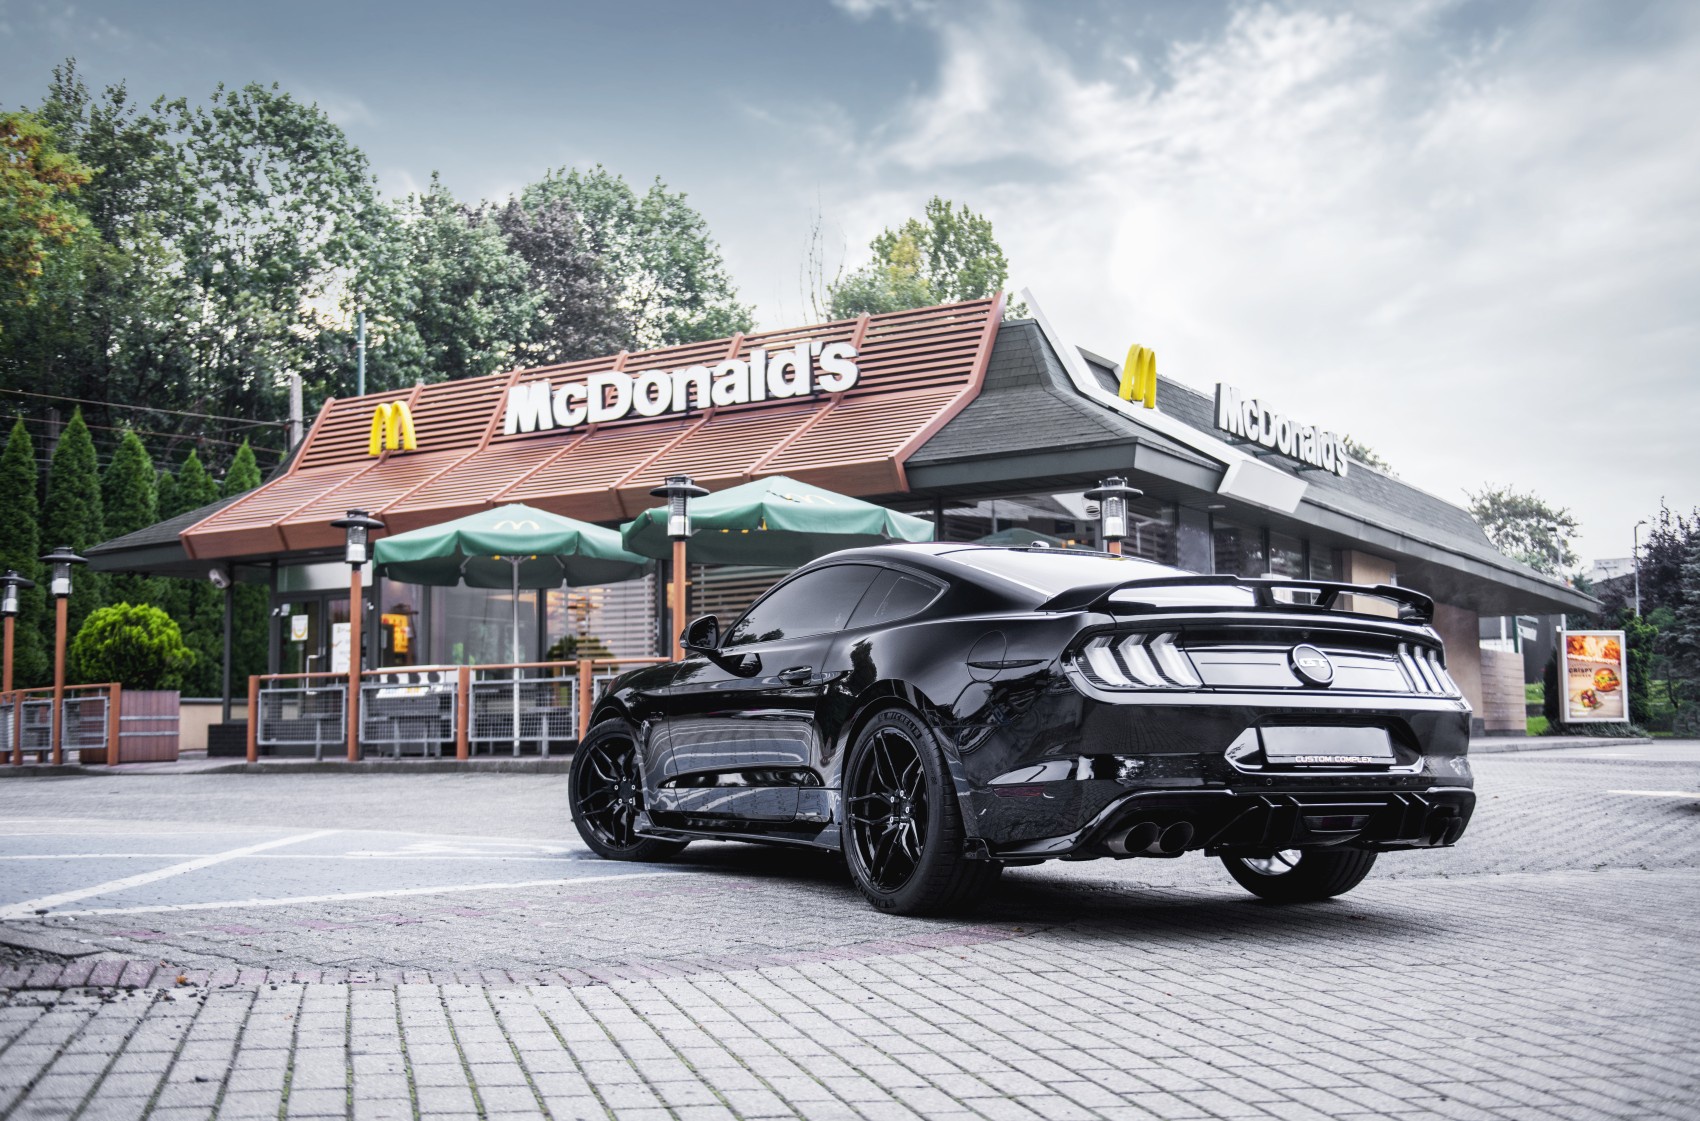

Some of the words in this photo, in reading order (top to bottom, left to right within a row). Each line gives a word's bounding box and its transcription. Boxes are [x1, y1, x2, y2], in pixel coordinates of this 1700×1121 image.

[504, 341, 860, 435] McDonald's
[1214, 382, 1348, 478] McDonald's
[1298, 657, 1328, 668] GT
[885, 712, 922, 739] MICHELIN
